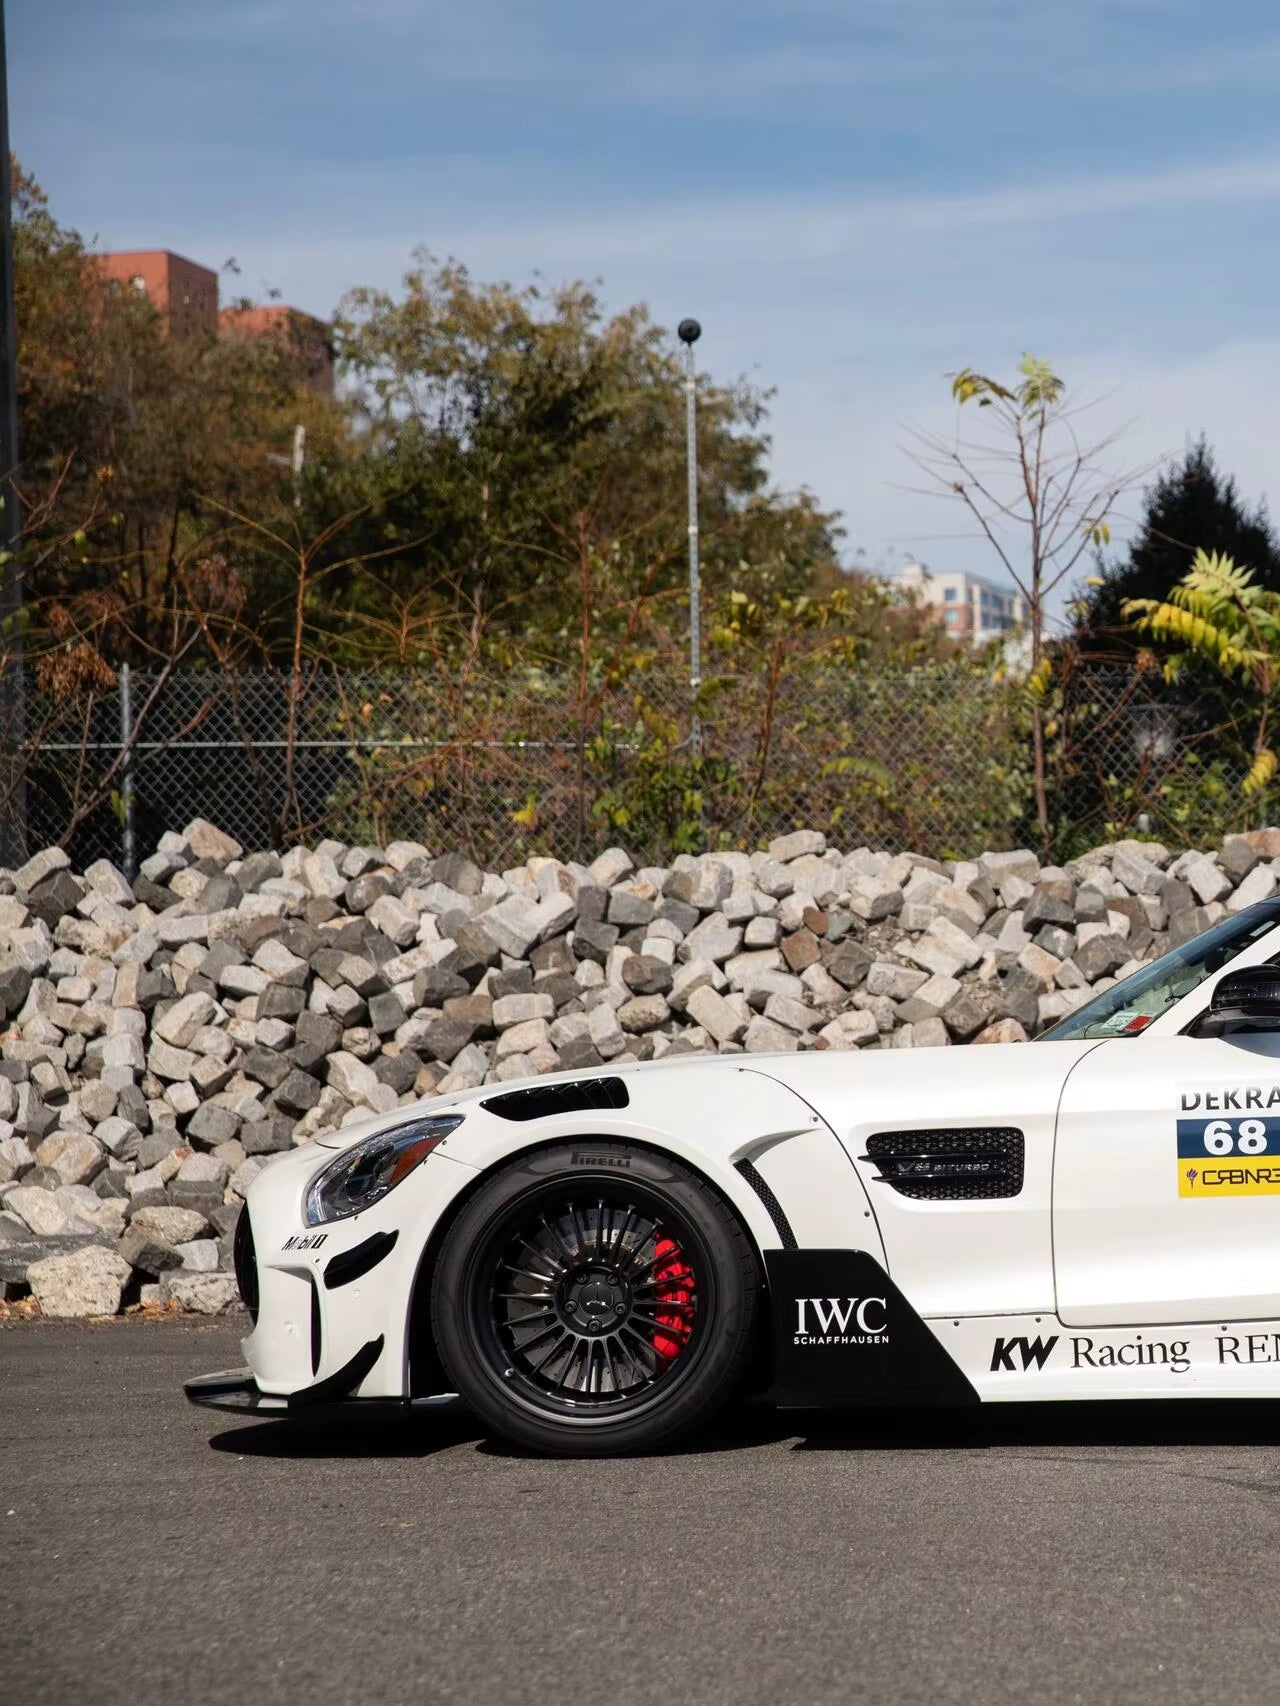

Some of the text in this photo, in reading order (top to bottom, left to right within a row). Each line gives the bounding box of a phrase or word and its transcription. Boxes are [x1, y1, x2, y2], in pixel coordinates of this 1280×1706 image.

[1203, 1119, 1268, 1156] 68
[570, 1151, 632, 1168] PIRELLI
[794, 1297, 888, 1334] IWC
[793, 1335, 889, 1345] SCHAFFHAUSEN
[989, 1334, 1191, 1373] KW Racing
